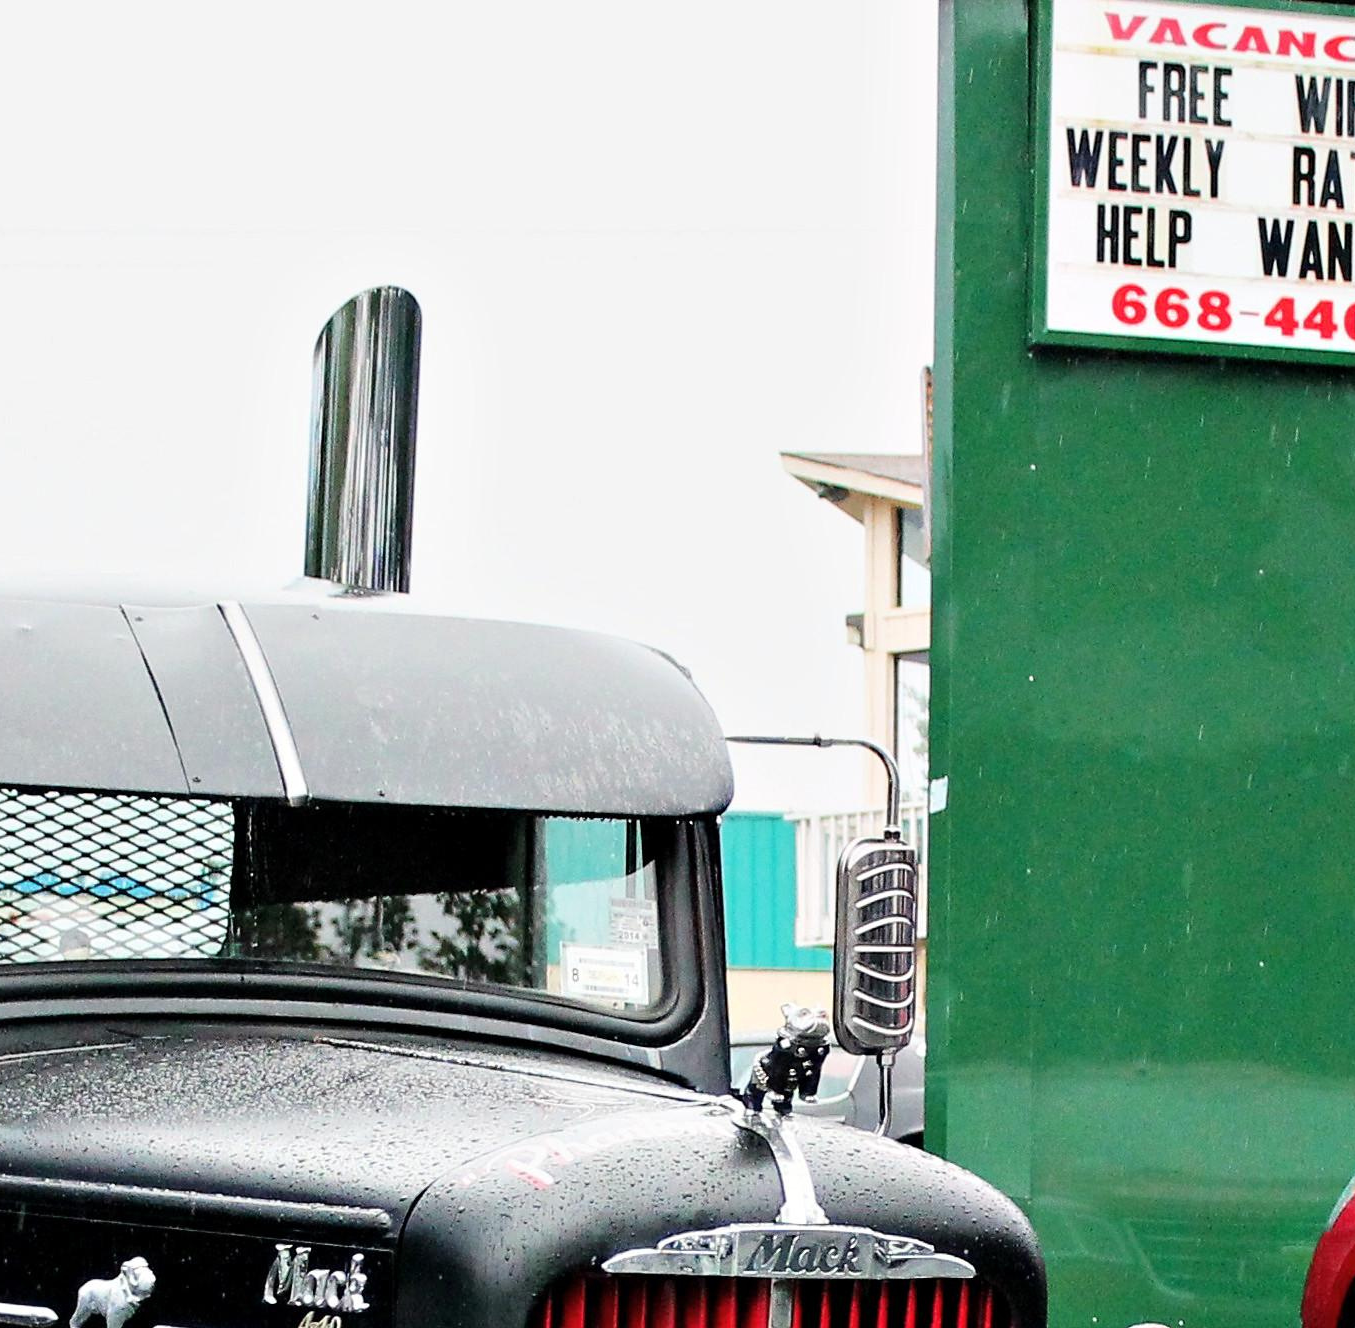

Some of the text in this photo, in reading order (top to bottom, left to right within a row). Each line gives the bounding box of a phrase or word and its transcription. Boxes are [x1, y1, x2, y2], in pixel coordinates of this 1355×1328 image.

[1138, 60, 1233, 127] FREE
[1066, 128, 1225, 199] WEEKLY
[1096, 203, 1193, 269] HELP
[262, 1243, 371, 1314] Mack
[743, 1233, 863, 1276] Mack
